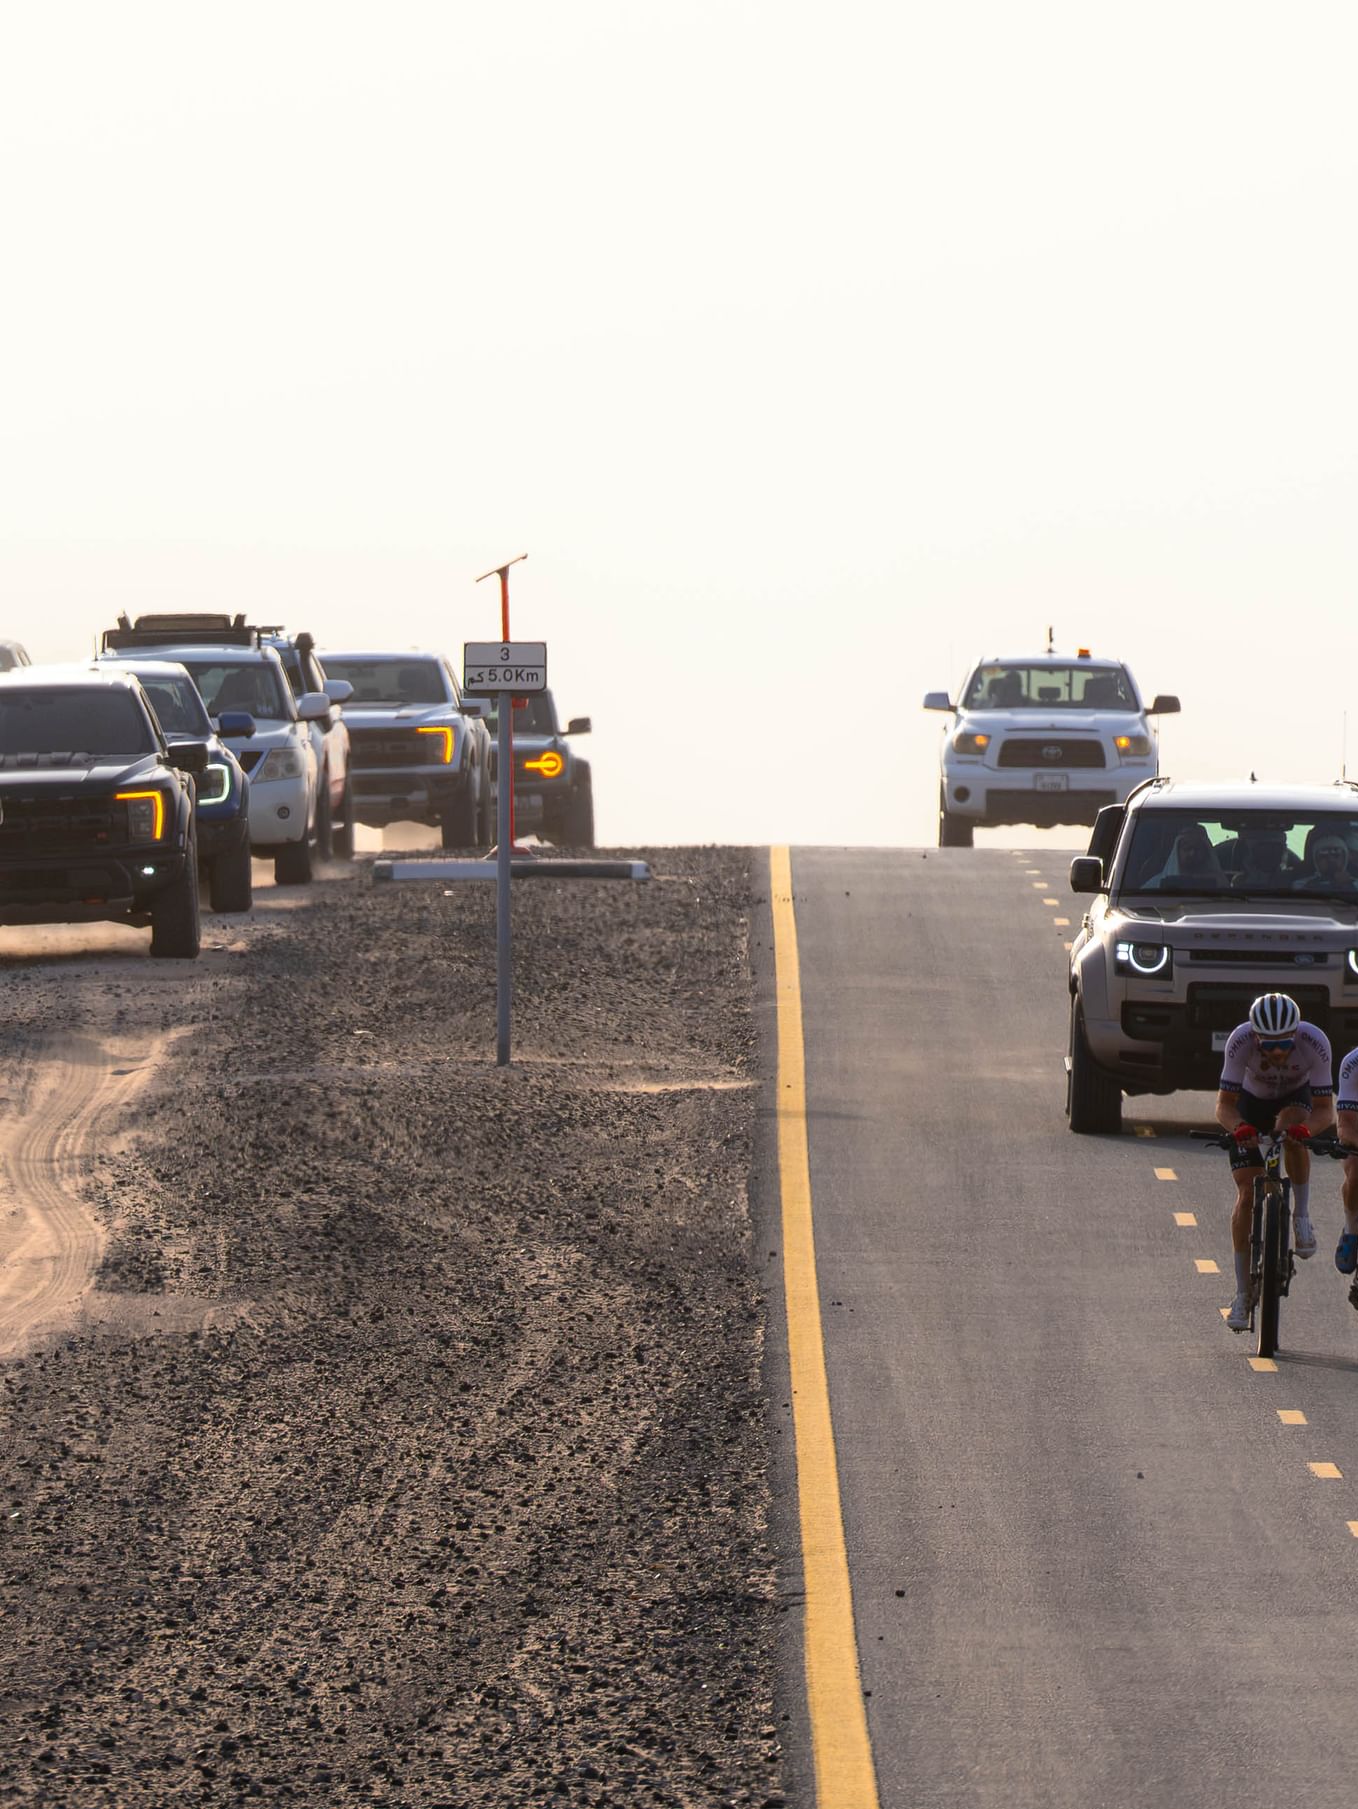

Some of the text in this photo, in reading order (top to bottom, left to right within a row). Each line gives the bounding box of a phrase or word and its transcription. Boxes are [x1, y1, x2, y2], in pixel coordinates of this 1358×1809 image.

[500, 647, 510, 661] 3
[488, 669, 539, 682] 5.0Km
[1301, 1032, 1329, 1063] OMNIYAT
